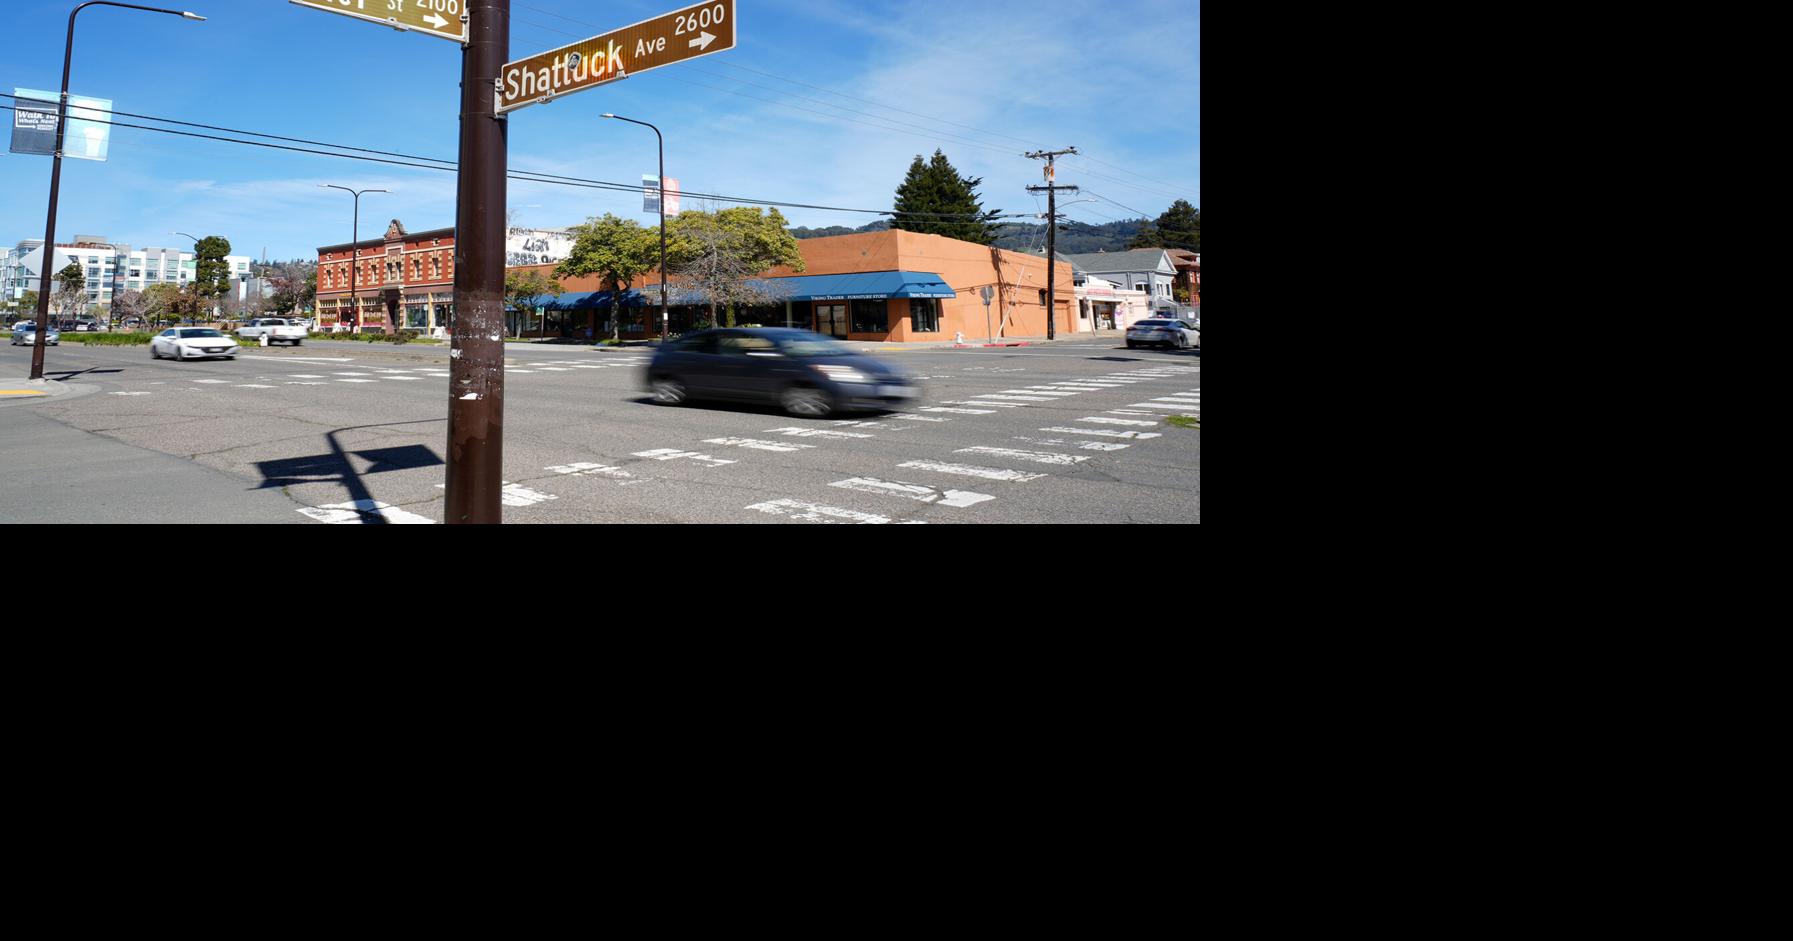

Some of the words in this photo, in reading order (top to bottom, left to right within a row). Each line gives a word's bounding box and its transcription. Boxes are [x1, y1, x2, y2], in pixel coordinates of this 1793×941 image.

[506, 39, 625, 100] Shattuck
[635, 36, 666, 58] Ave
[674, 3, 725, 36] 2600
